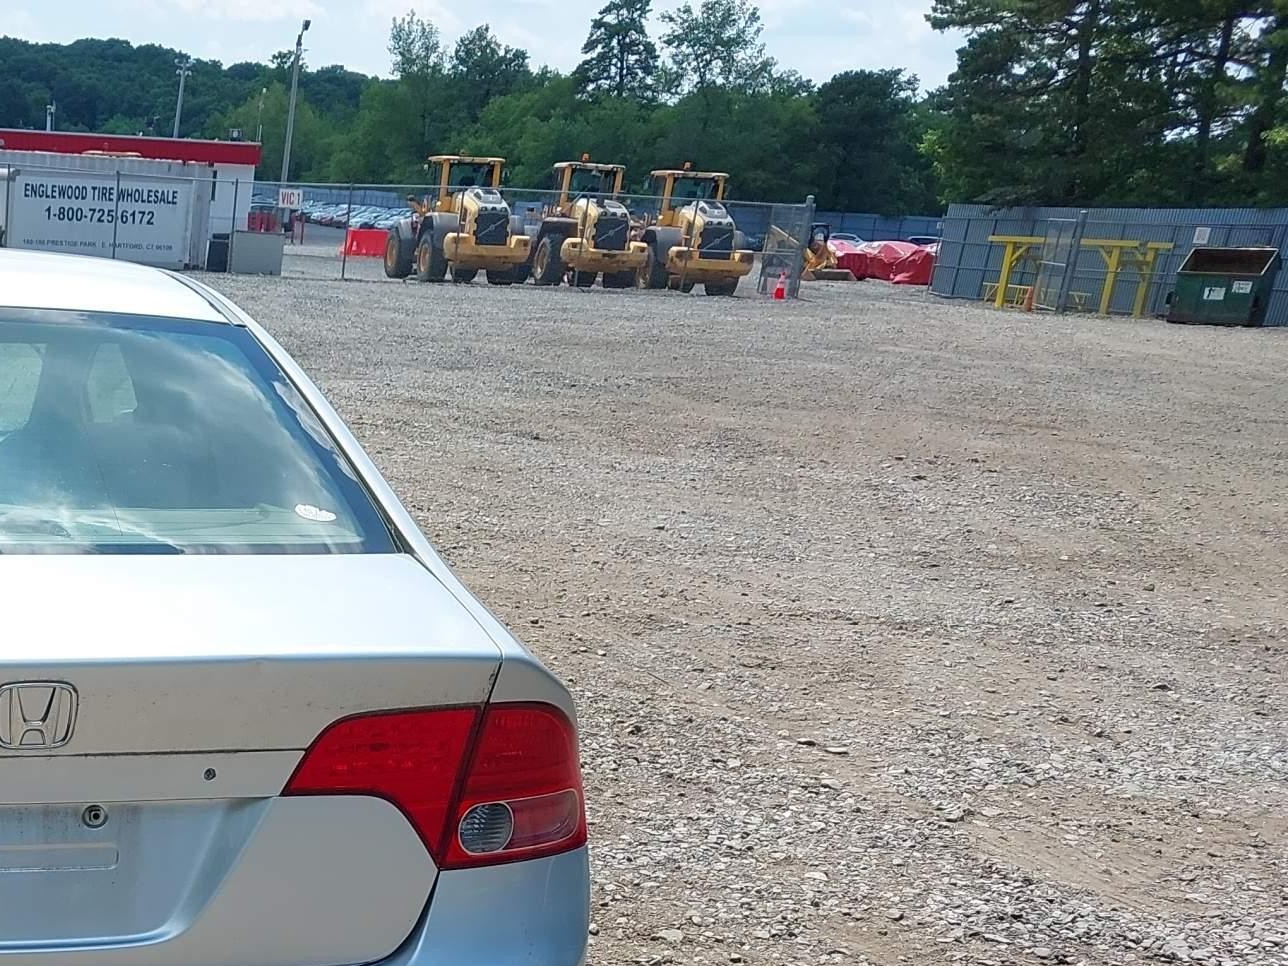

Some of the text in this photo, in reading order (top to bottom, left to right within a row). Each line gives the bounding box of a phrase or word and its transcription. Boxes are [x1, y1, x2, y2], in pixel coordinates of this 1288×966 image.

[23, 183, 179, 205] ENGLEWOOD TIRE WHOLESALE
[281, 192, 295, 205] VIC
[47, 239, 77, 248] PRESTIGE
[79, 240, 97, 249] PARK
